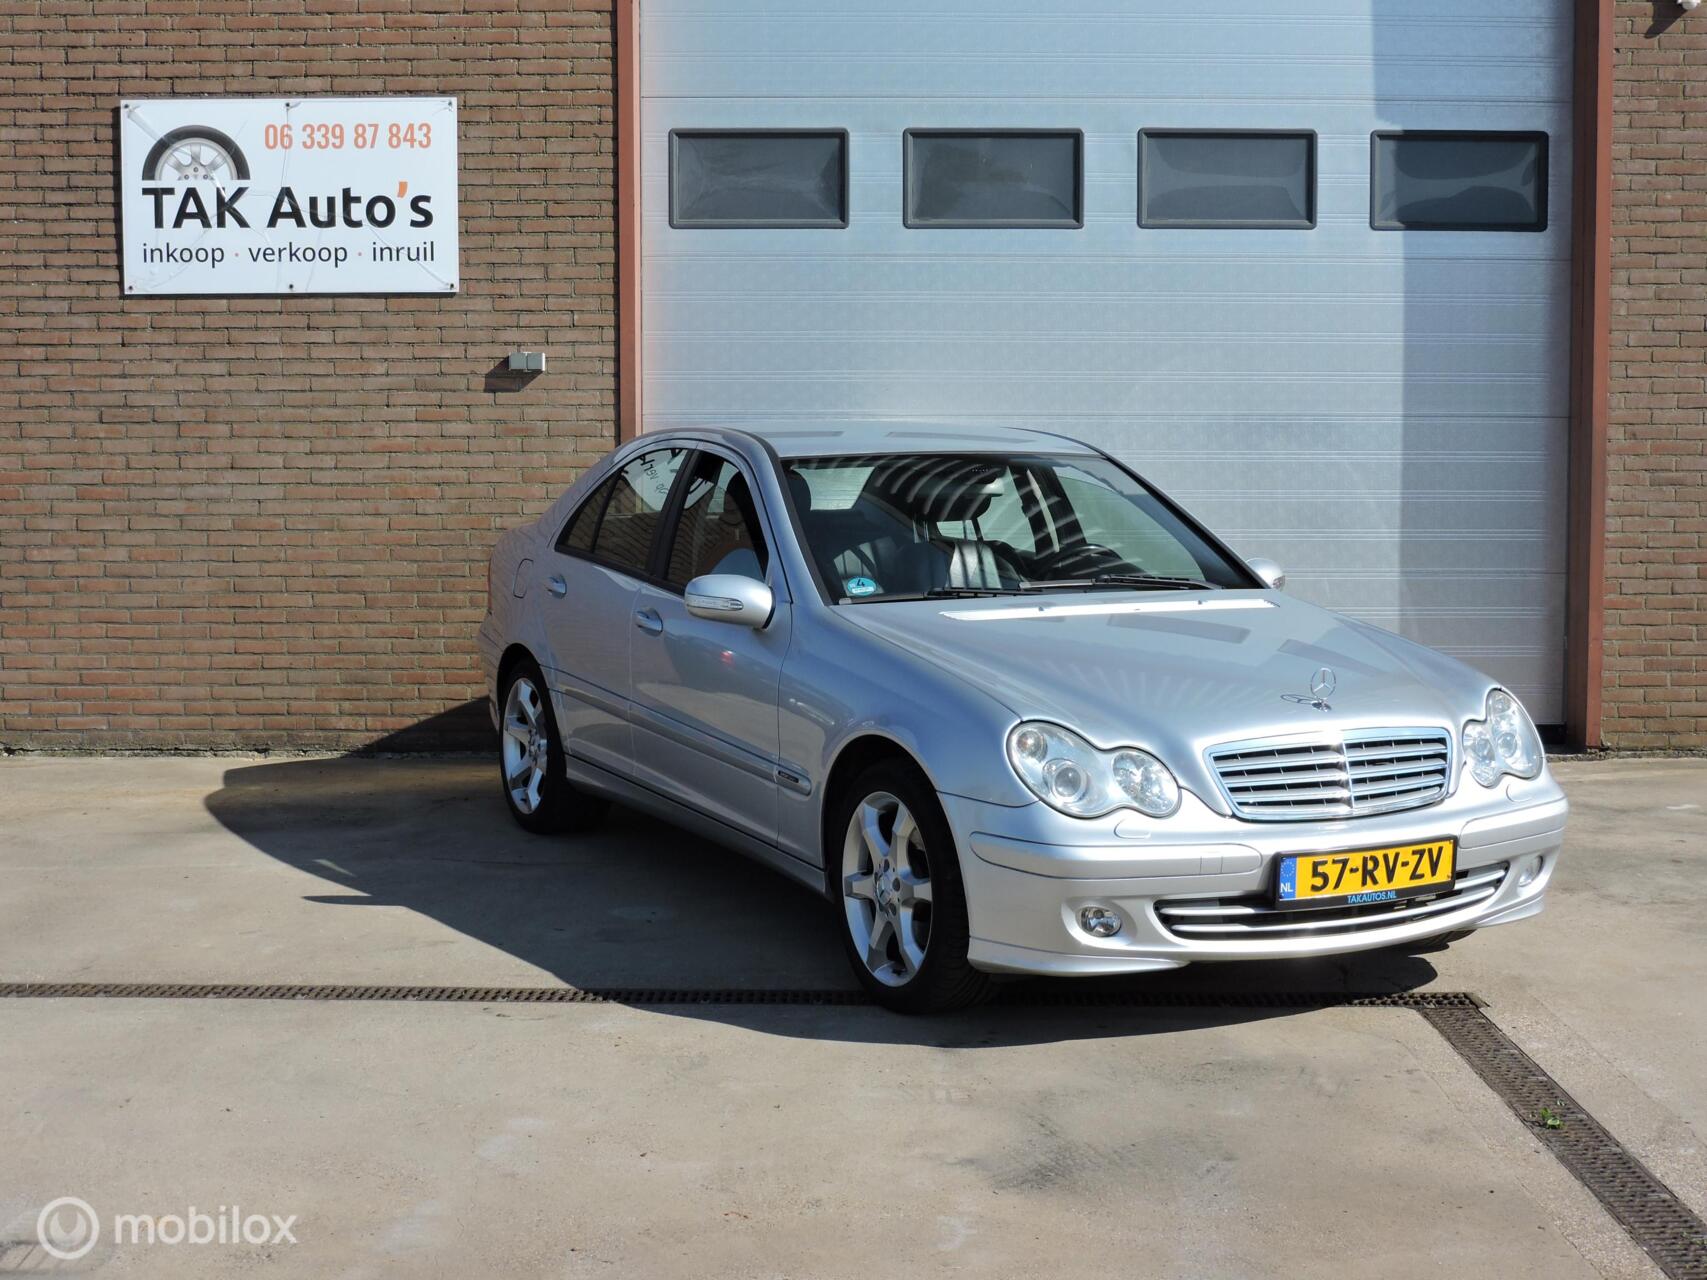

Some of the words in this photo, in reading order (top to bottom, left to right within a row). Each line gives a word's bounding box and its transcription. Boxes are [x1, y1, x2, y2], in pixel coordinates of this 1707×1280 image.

[265, 124, 293, 149] 06
[302, 123, 344, 149] 339
[354, 123, 379, 149] 87
[388, 123, 432, 149] 843
[142, 187, 251, 228] TAK
[267, 181, 434, 228] Auto's
[143, 242, 224, 268] inkoop
[248, 242, 347, 268] verkoop
[373, 241, 435, 262] inruil
[1310, 846, 1443, 892] 57-RV-ZV
[1280, 882, 1294, 893] NL
[1347, 890, 1397, 904] TAKAUTOS.NL
